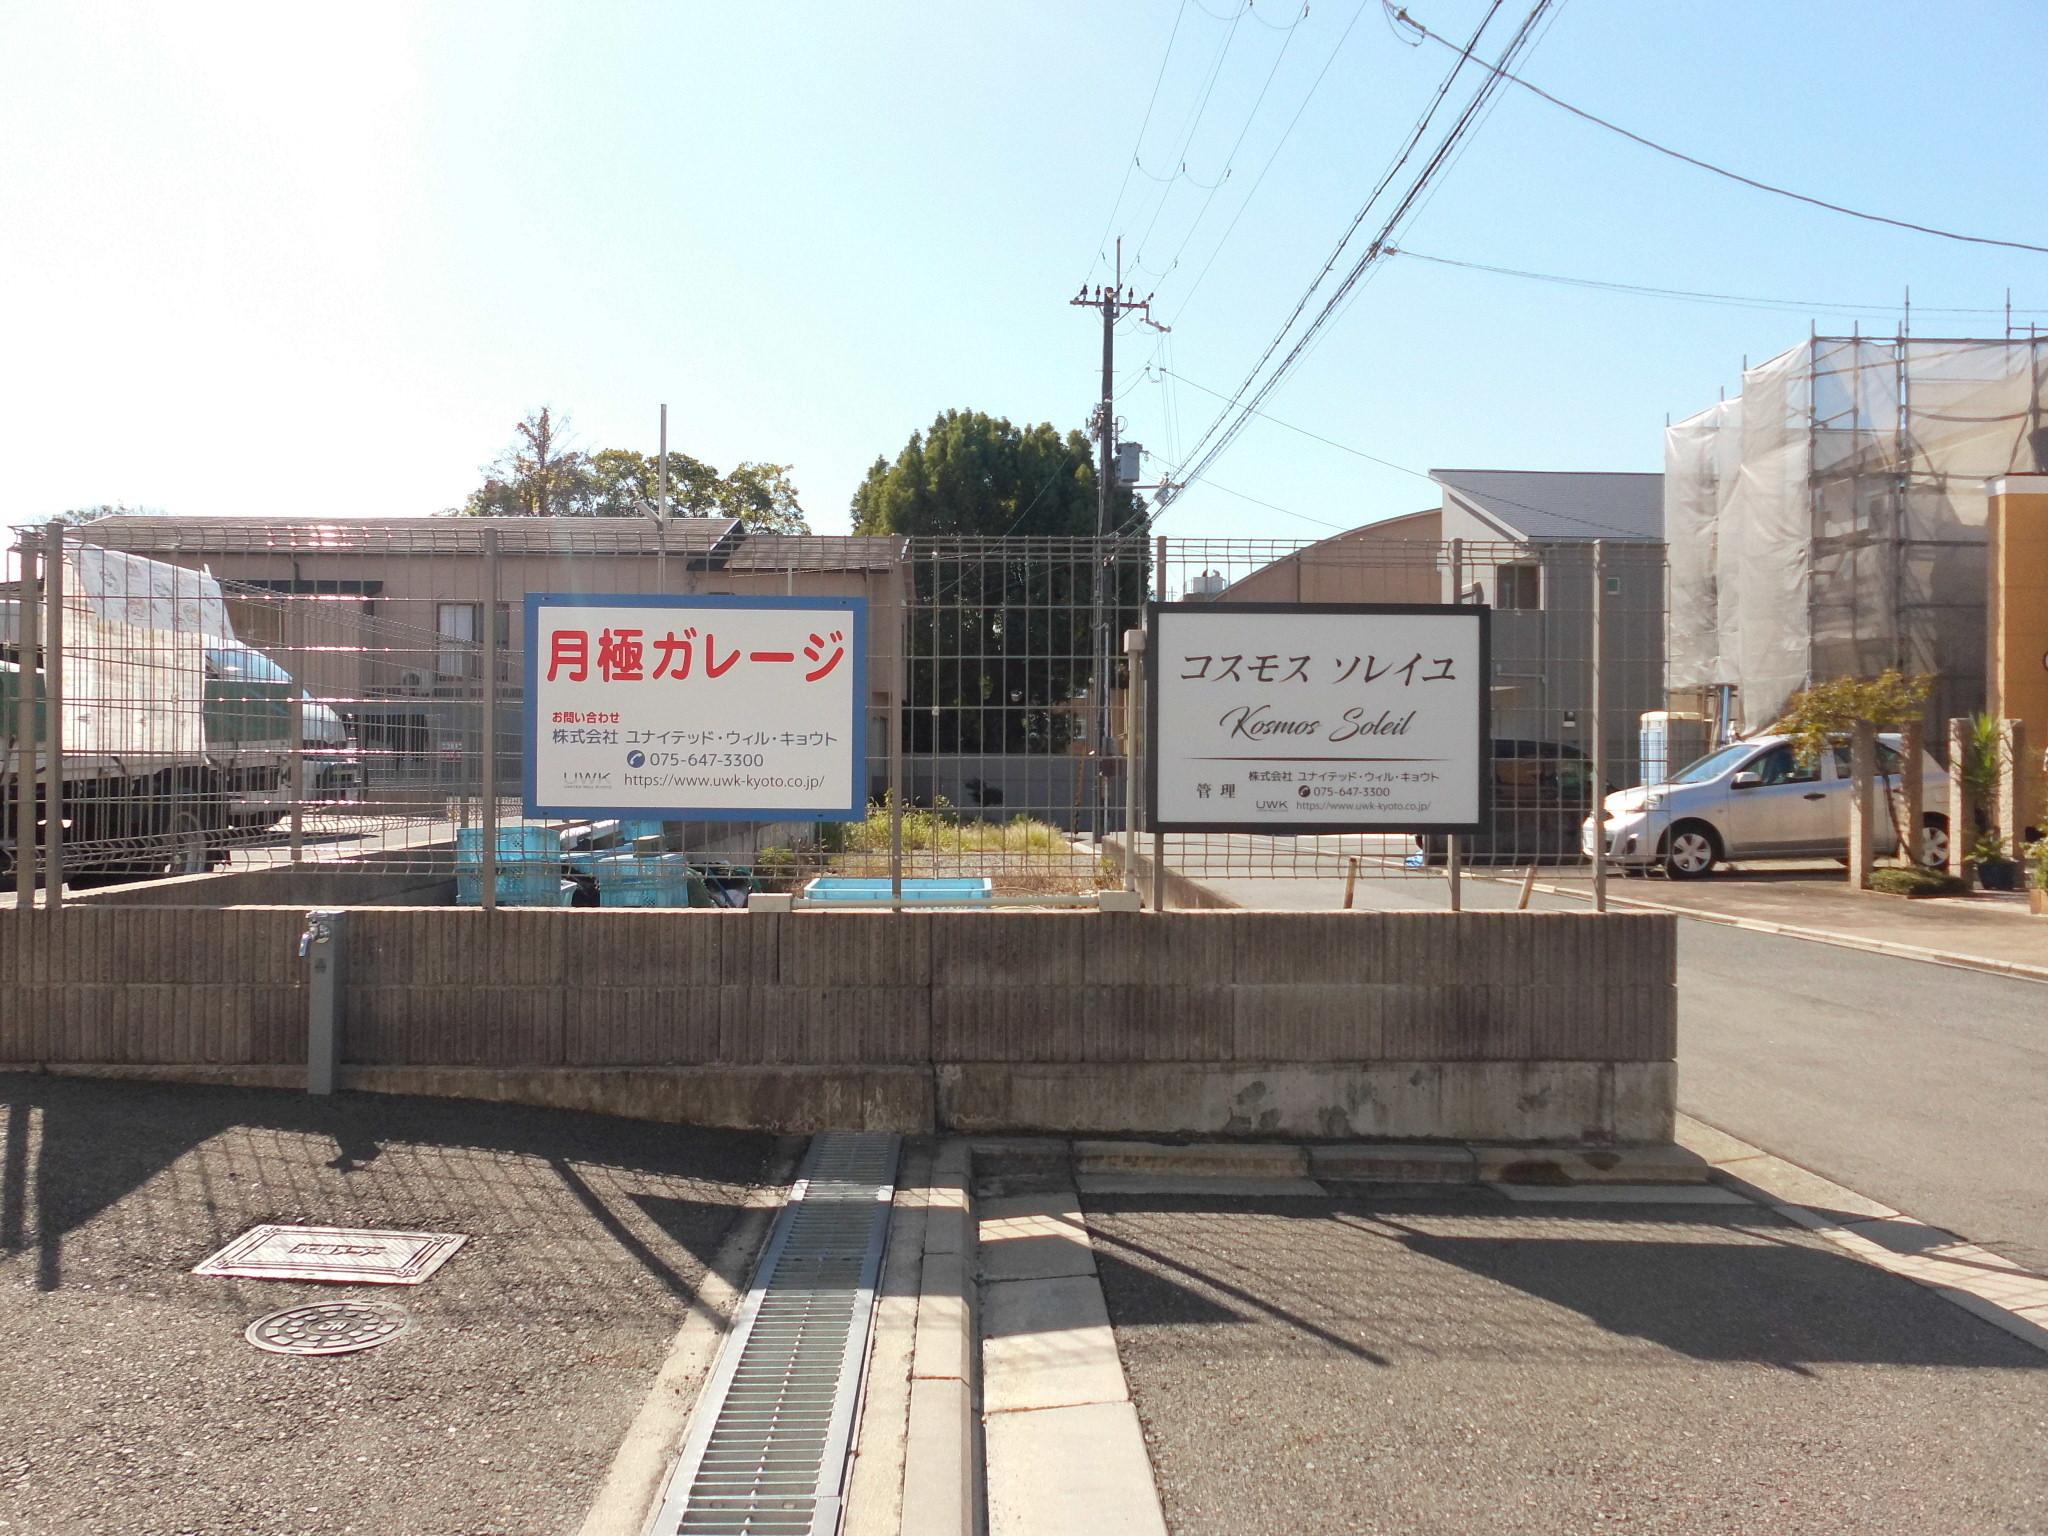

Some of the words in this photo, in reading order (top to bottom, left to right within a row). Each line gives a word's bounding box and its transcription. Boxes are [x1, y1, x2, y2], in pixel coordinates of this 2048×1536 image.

[546, 626, 845, 683] 月極ガレージ
[1180, 653, 1312, 683] コスモス
[1332, 652, 1456, 687] ソレイユ
[552, 711, 621, 724] お問い合わせ
[1219, 704, 1320, 742] Kosmos
[1329, 706, 1418, 742] Soleil
[552, 728, 619, 745] 株式会社
[625, 730, 838, 747] ユナイテッド・ウィル・キョウト
[650, 752, 764, 768] 075-647-3300
[624, 773, 825, 791] https://www.uwk-kyoto.co.jp/
[1248, 770, 1293, 782] 株式会社
[1196, 782, 1237, 799] 管理
[1313, 786, 1390, 797] 075-647-3300
[1255, 800, 1289, 809] UWK
[1296, 799, 1431, 811] https://www.uwk-kyoto.co.jp/
